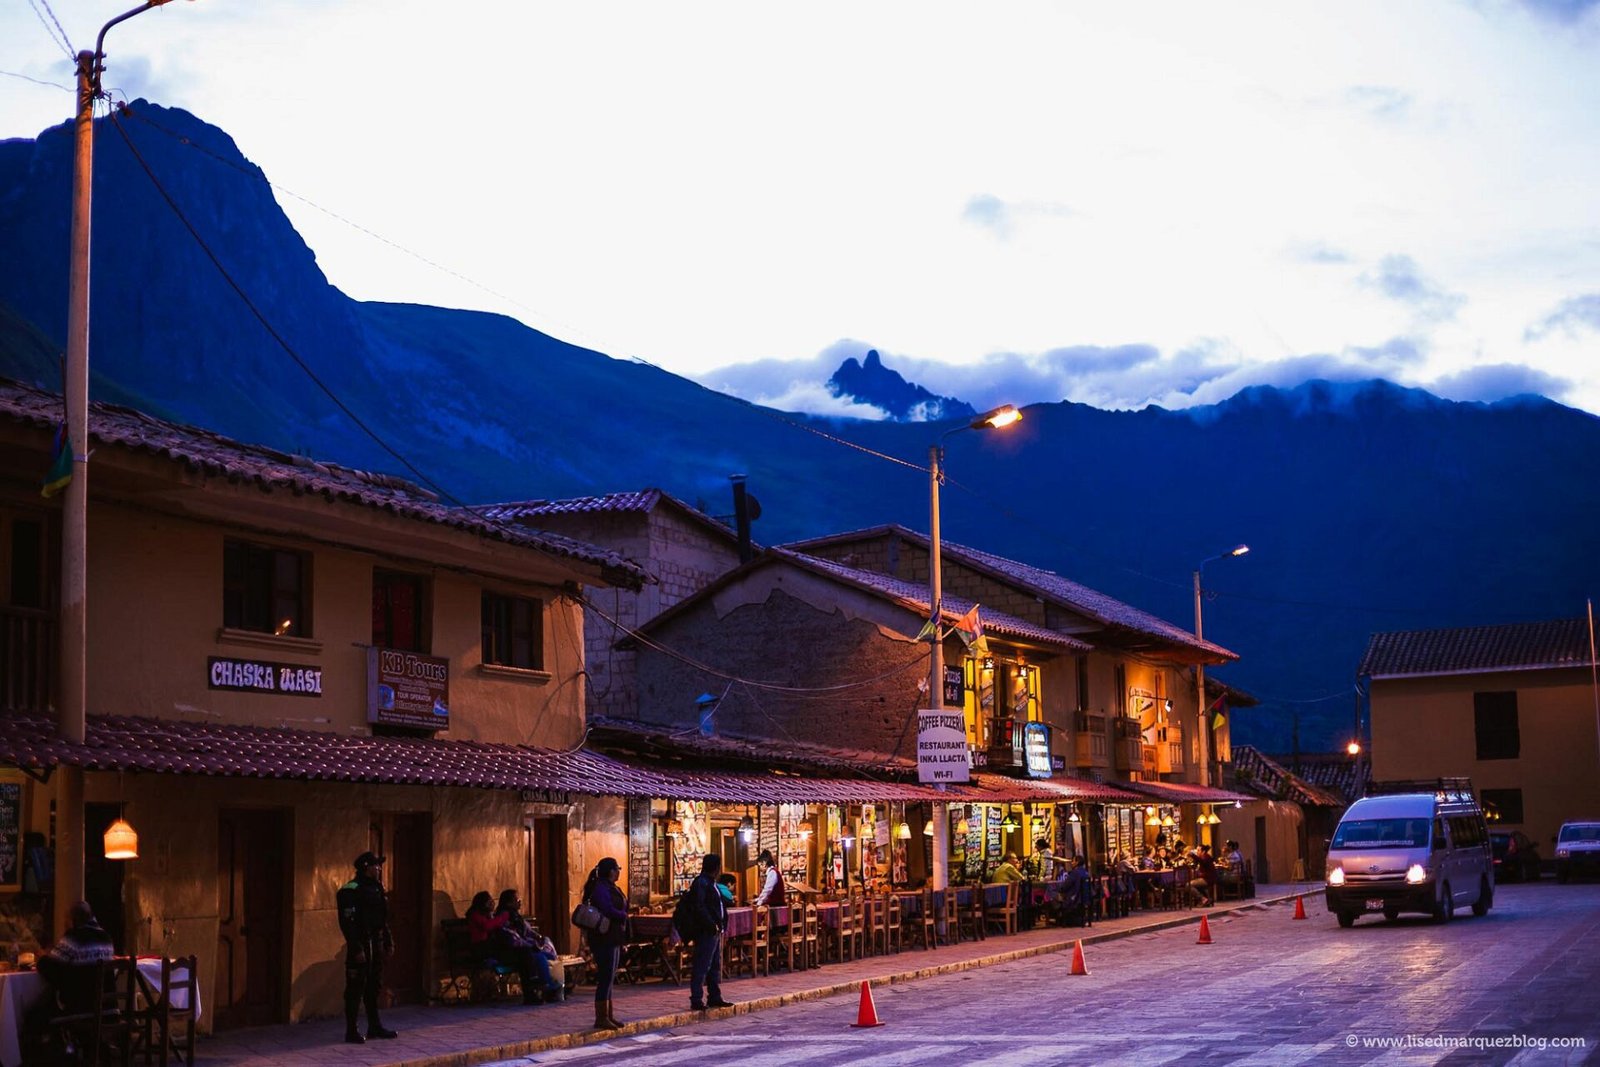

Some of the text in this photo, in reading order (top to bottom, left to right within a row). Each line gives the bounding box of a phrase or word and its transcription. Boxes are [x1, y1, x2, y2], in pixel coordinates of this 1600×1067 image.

[382, 651, 447, 682] KB Tours
[211, 662, 321, 693] CHASKA WASI
[397, 691, 432, 702] TOUR OPERATOR
[918, 715, 967, 735] COFFEE PIZZERIA
[919, 742, 965, 750] RESTAURANT
[920, 754, 966, 763] INKA LLACTA
[934, 771, 953, 779] WI-FI
